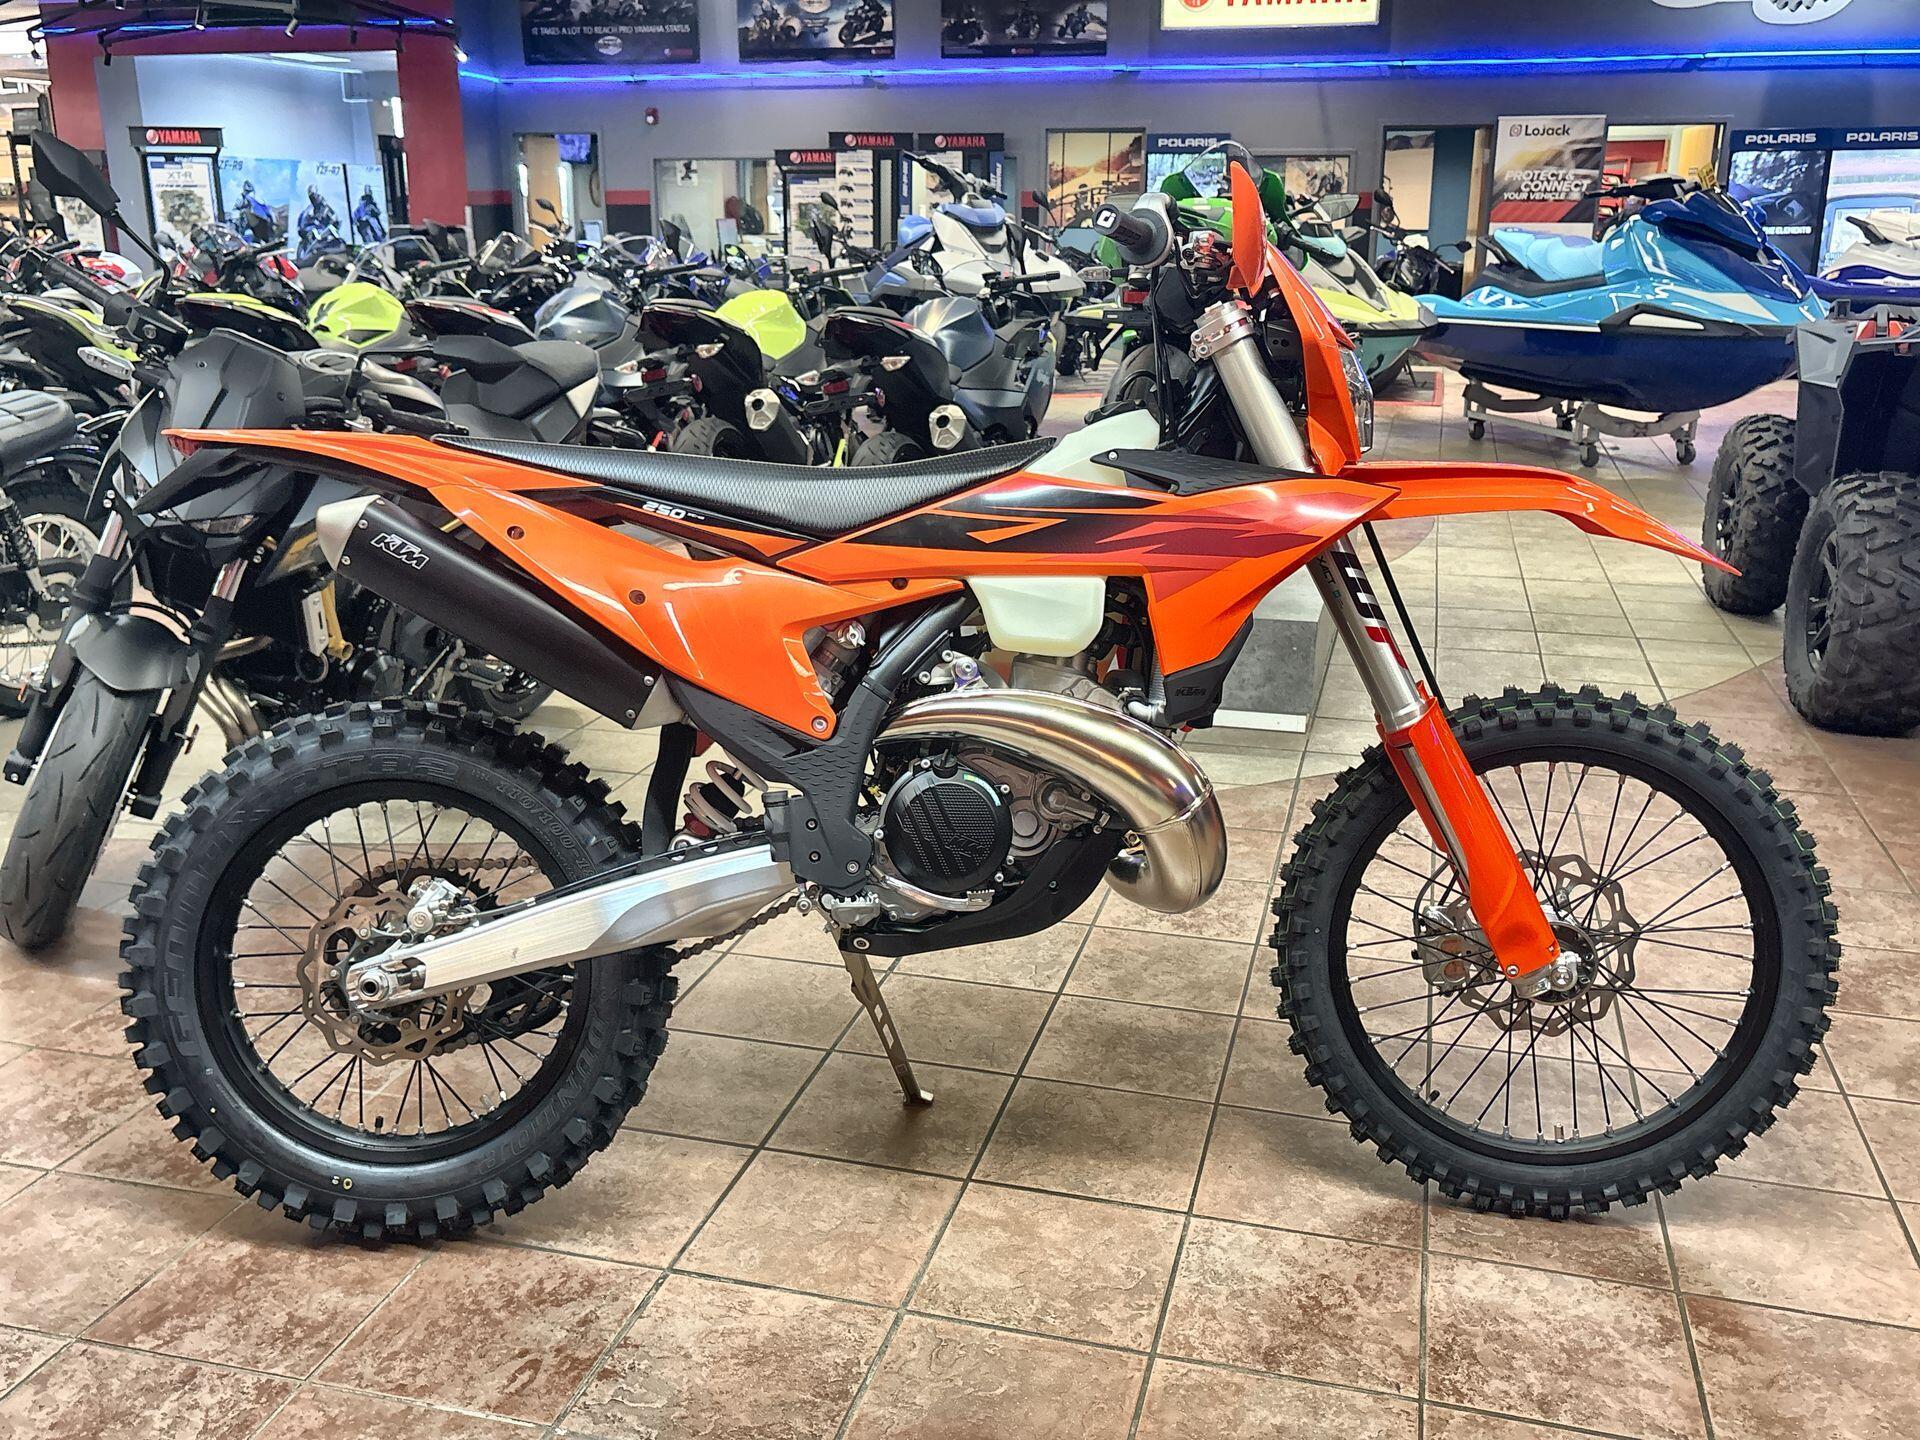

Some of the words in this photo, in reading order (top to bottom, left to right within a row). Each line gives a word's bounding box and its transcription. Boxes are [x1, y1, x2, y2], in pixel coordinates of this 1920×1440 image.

[568, 26, 580, 35] LOT
[583, 26, 593, 34] TO
[594, 26, 617, 34] REACH
[619, 25, 633, 33] PRO
[634, 25, 664, 33] YAMAHA
[665, 24, 690, 32] STATUS
[158, 130, 201, 143] YAMAHA
[857, 135, 895, 147] YAMAHA
[947, 136, 986, 147] YAMAHA
[1745, 133, 1816, 144] POLARIS
[1846, 131, 1919, 142] POLARIS
[1158, 138, 1217, 147] POLARIS
[801, 152, 832, 163] YAMAH
[218, 160, 243, 171] ZF-R9
[1505, 169, 1566, 181] PROTECT
[1566, 170, 1575, 181] &
[1520, 180, 1591, 192] CONNECT
[1504, 192, 1528, 200] YOUR
[1530, 192, 1566, 200] VEHICLE
[642, 501, 686, 519] 250
[370, 533, 429, 569] KTM
